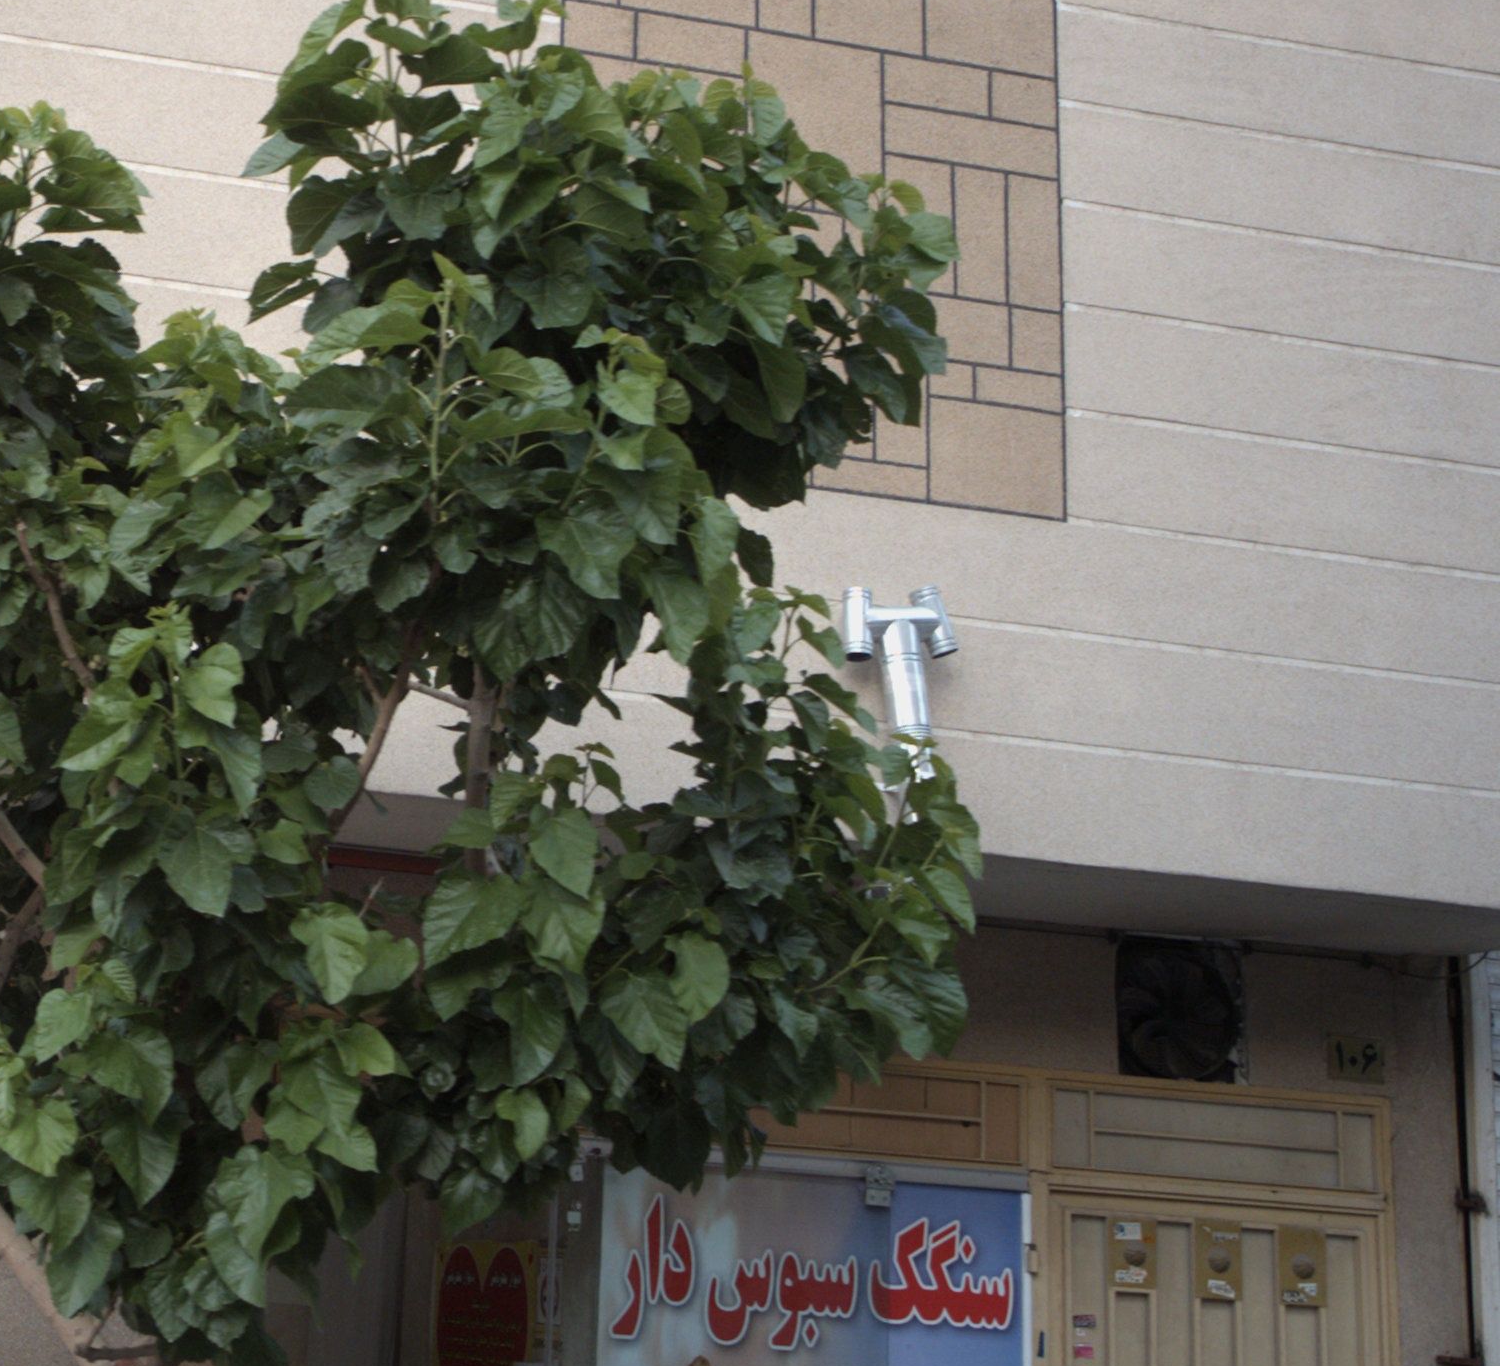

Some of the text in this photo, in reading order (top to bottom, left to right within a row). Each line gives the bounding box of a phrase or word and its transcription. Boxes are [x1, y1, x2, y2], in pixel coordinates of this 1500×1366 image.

[1334, 1040, 1378, 1074] ۱۰۶
[608, 1193, 1014, 1351] سنگک سبوس دار
